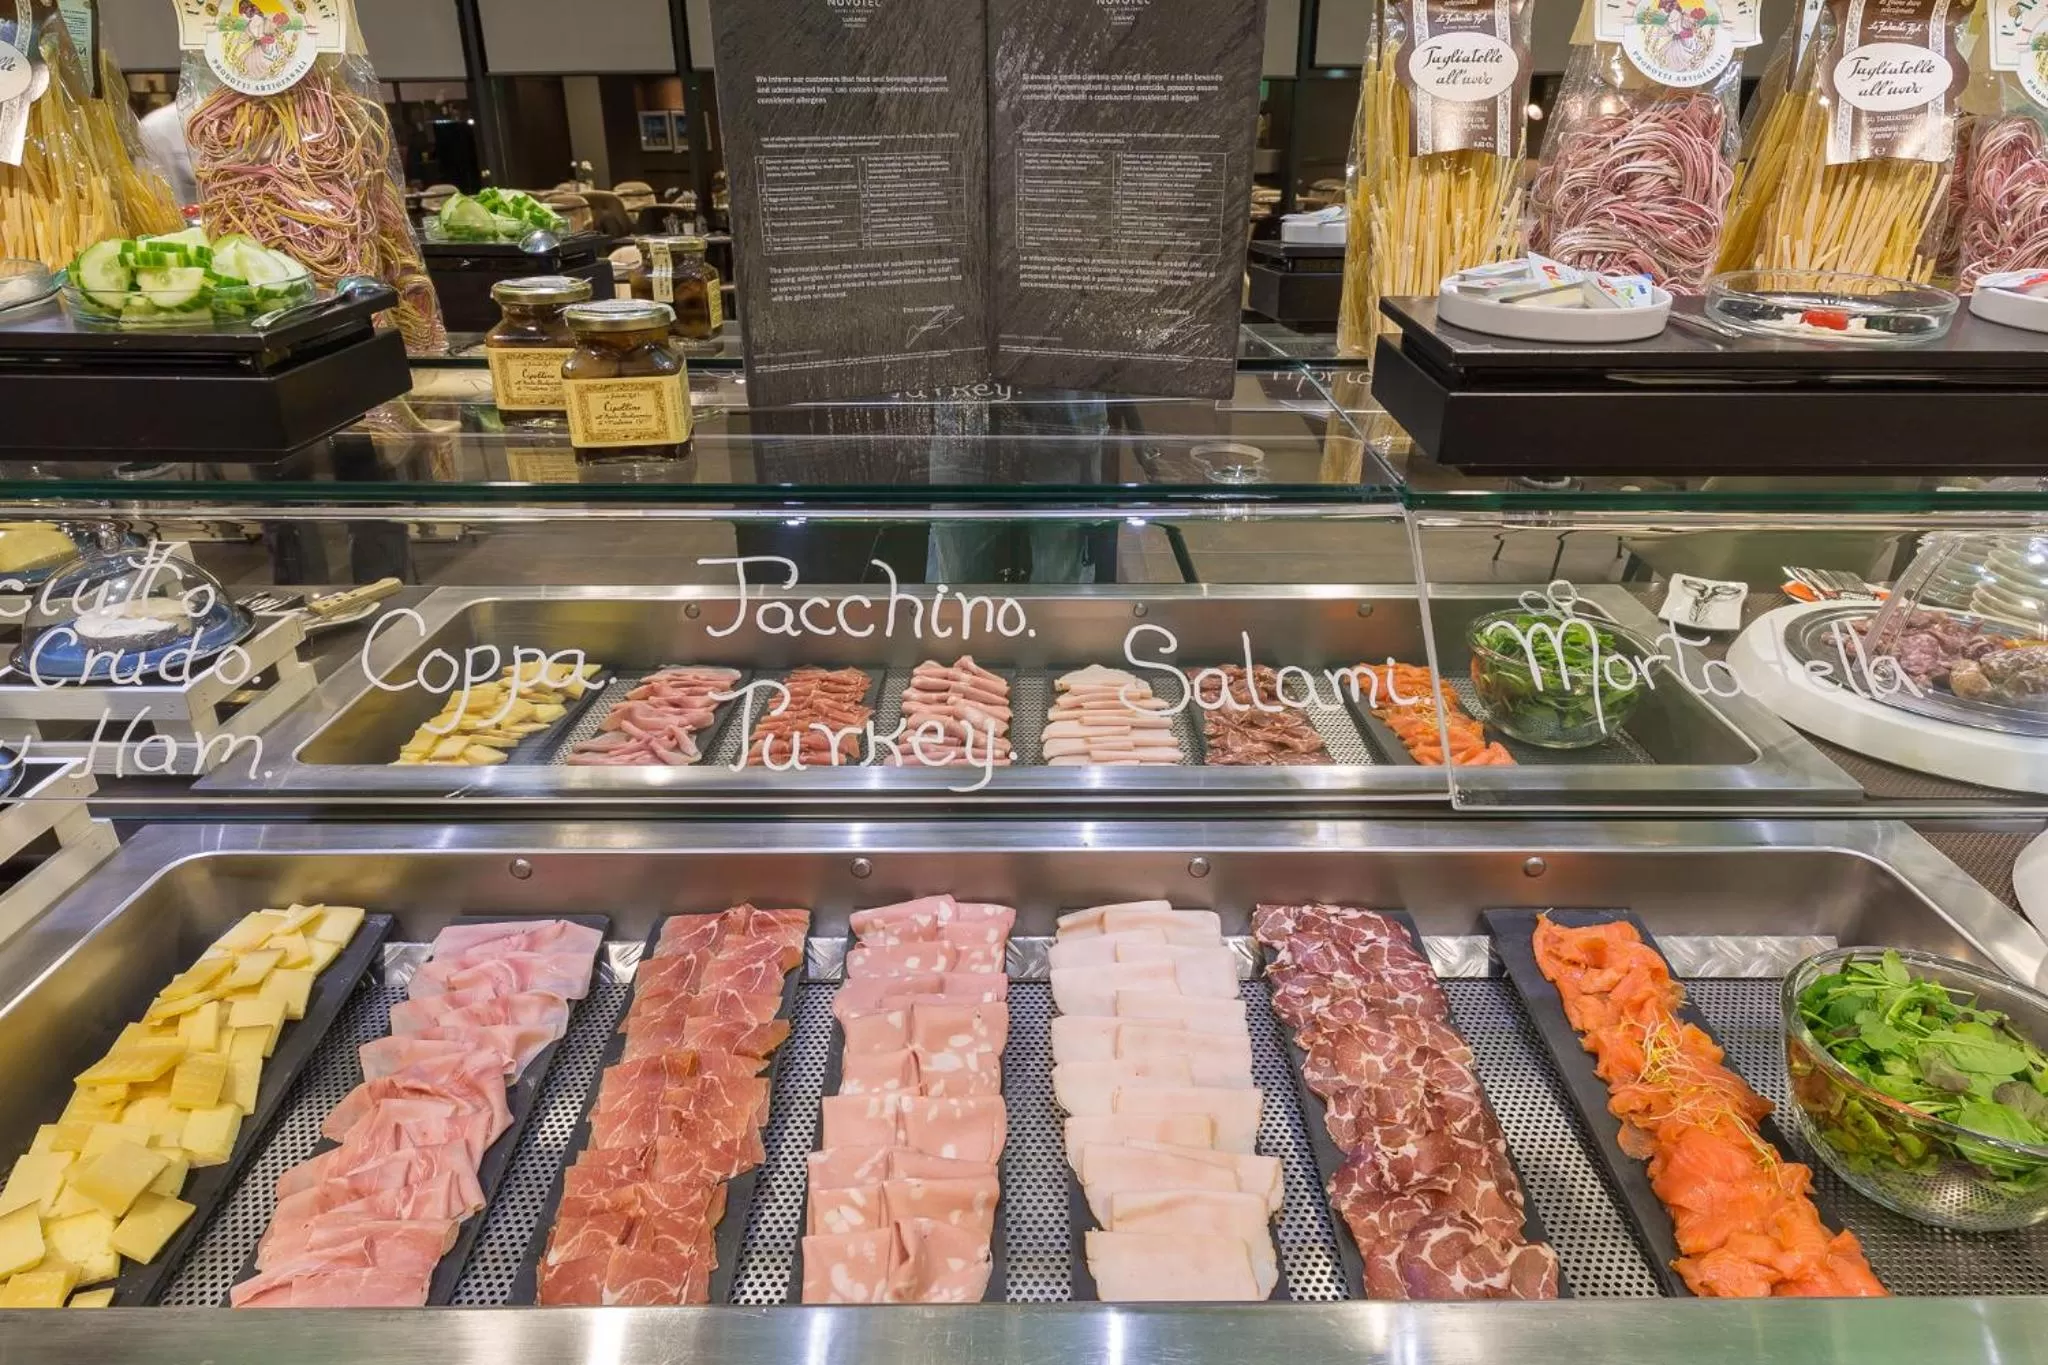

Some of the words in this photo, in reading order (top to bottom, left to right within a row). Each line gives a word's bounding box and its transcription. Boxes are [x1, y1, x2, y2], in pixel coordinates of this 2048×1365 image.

[1421, 45, 1503, 70] Tagliatelle
[1847, 56, 1936, 82] Tagliatelle
[696, 555, 1036, 640] Tacchino.
[29, 626, 262, 691] Crudo.
[361, 607, 619, 735] Coppa.
[1118, 622, 1433, 718] Salami.
[68, 705, 274, 780] Ham.
[707, 678, 1017, 792] Turkey.
